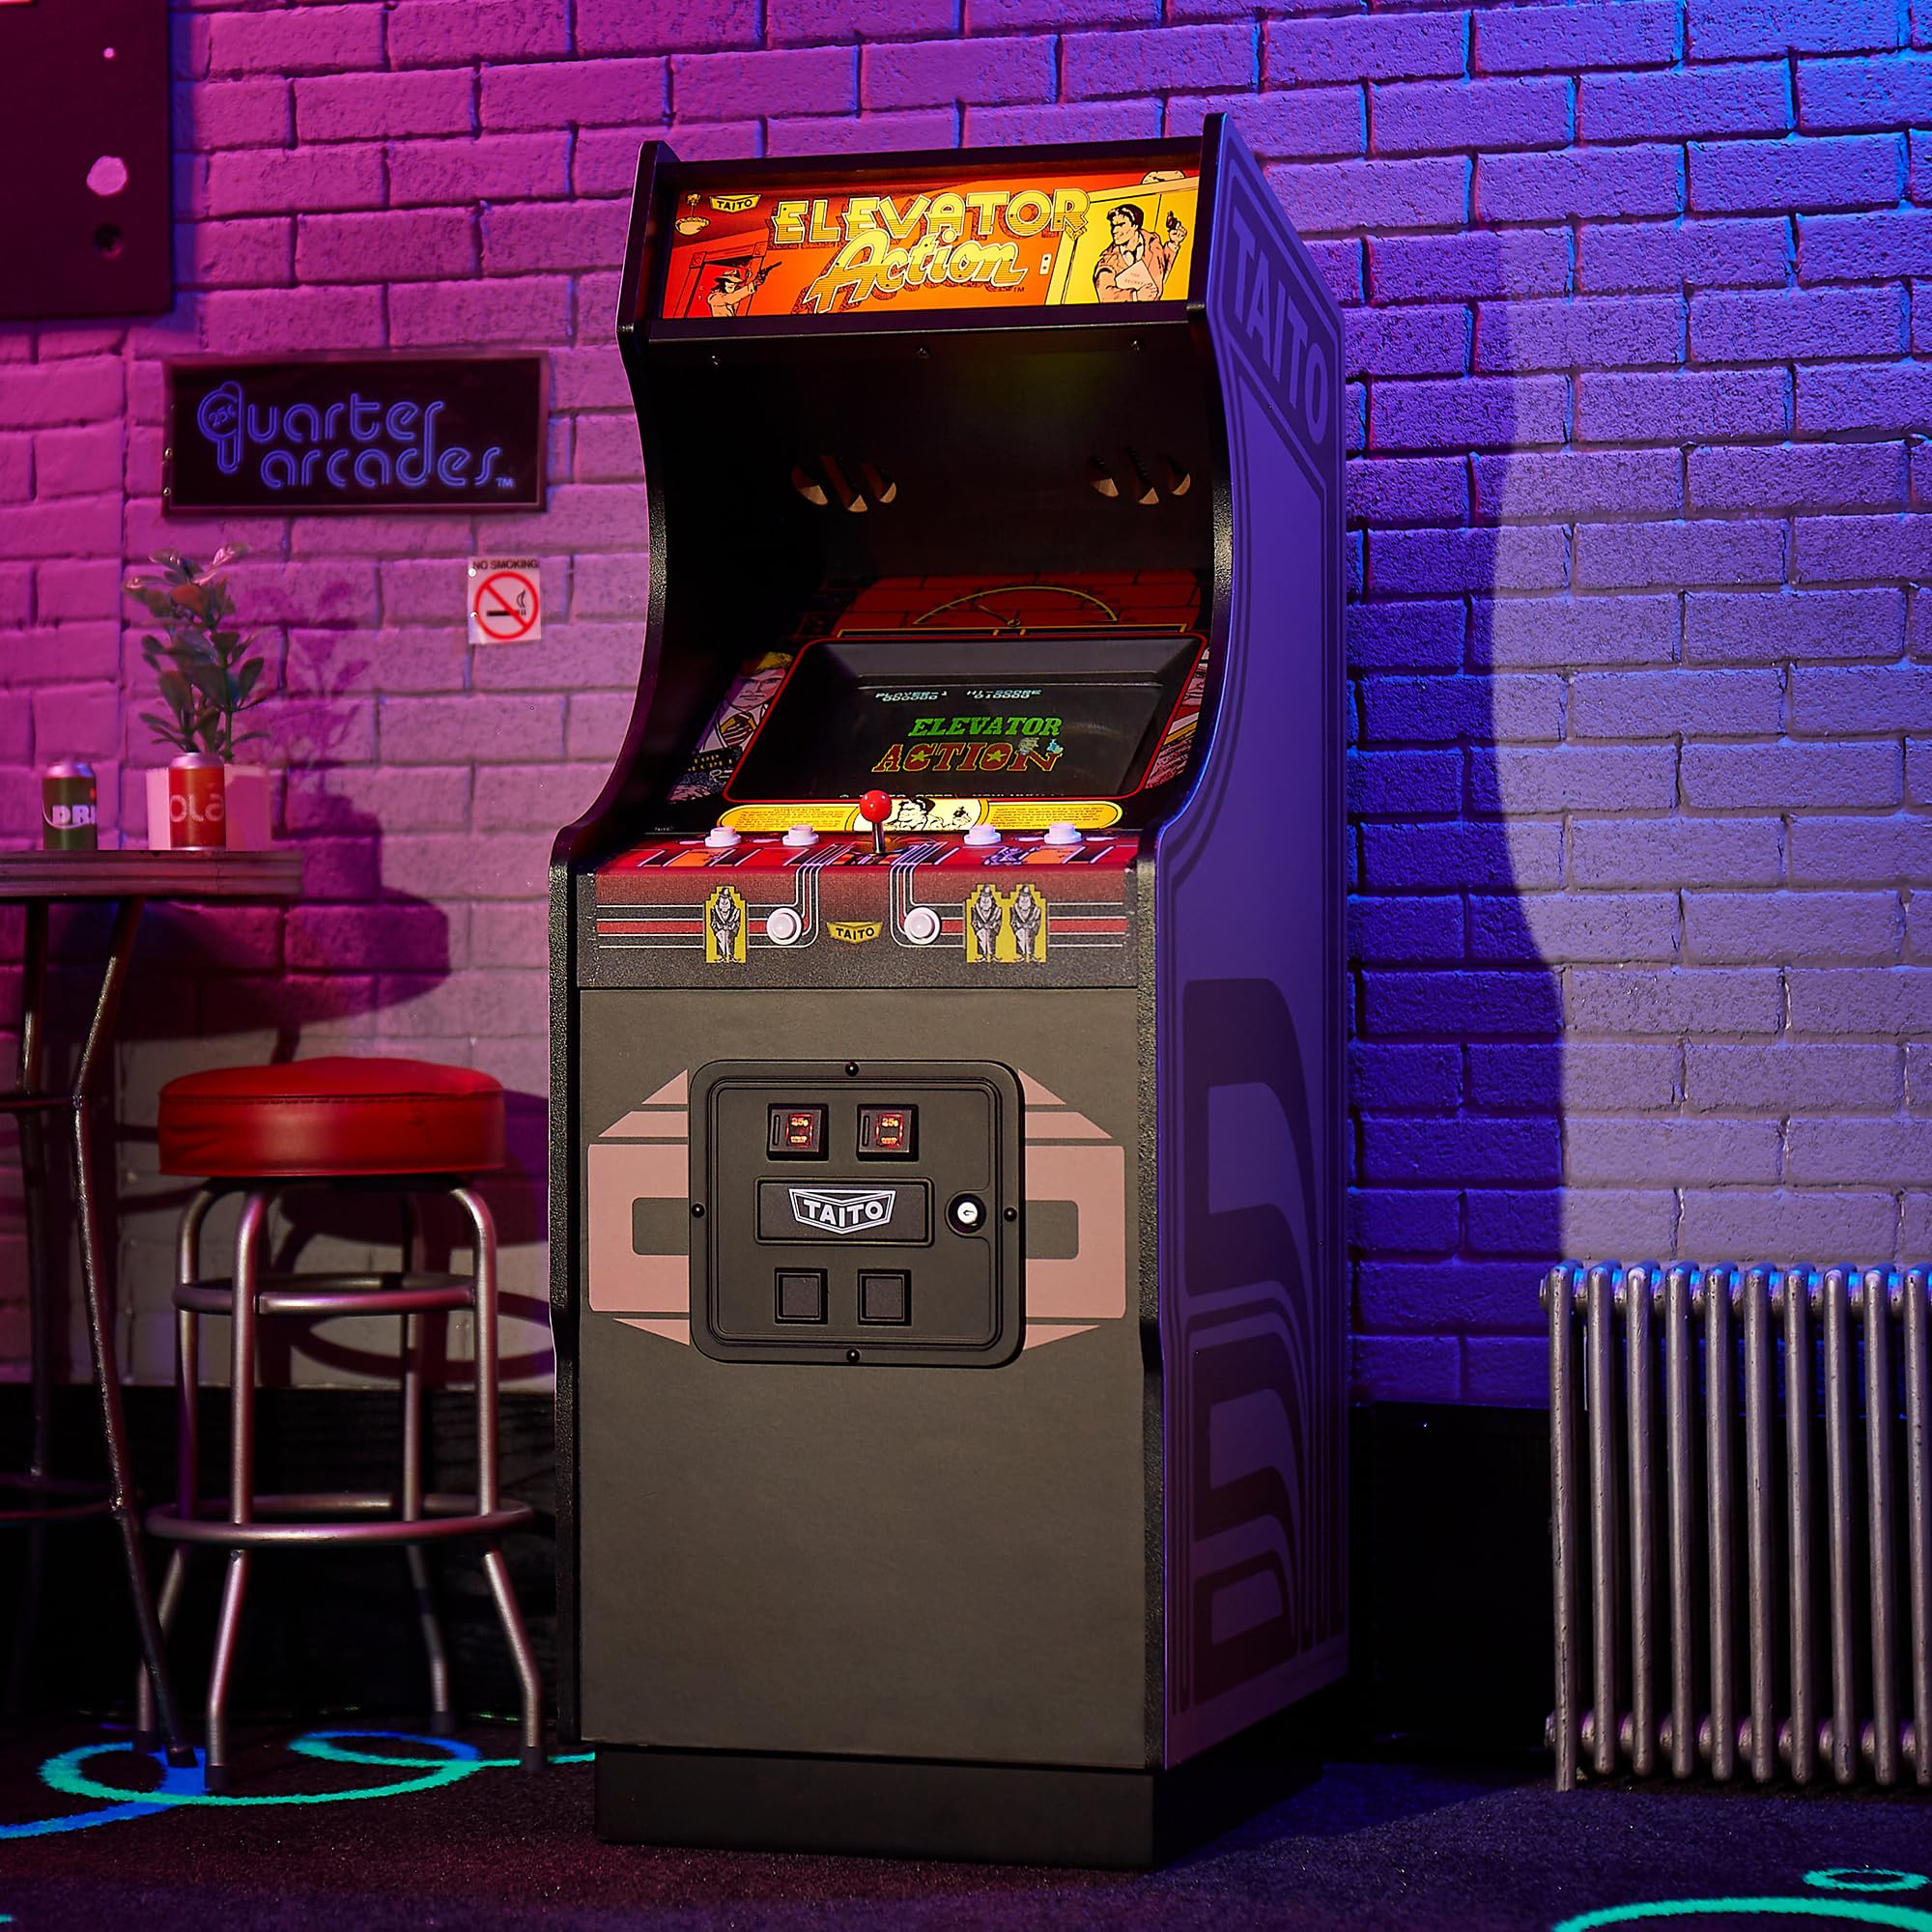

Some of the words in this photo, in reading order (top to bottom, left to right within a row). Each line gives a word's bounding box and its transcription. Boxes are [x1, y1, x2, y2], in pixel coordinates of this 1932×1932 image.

[716, 199, 753, 211] TAITO
[771, 189, 1090, 244] ELEVATOR
[803, 227, 1028, 315] Action
[1232, 205, 1329, 445] TAITO
[261, 446, 500, 489] arcades
[472, 560, 489, 570] NO
[490, 559, 540, 570] SMOKING
[907, 717, 1064, 737] ELEVATOR
[871, 742, 1064, 773] ACTION
[836, 926, 875, 941] TAITO
[803, 1201, 884, 1228] TAITO
